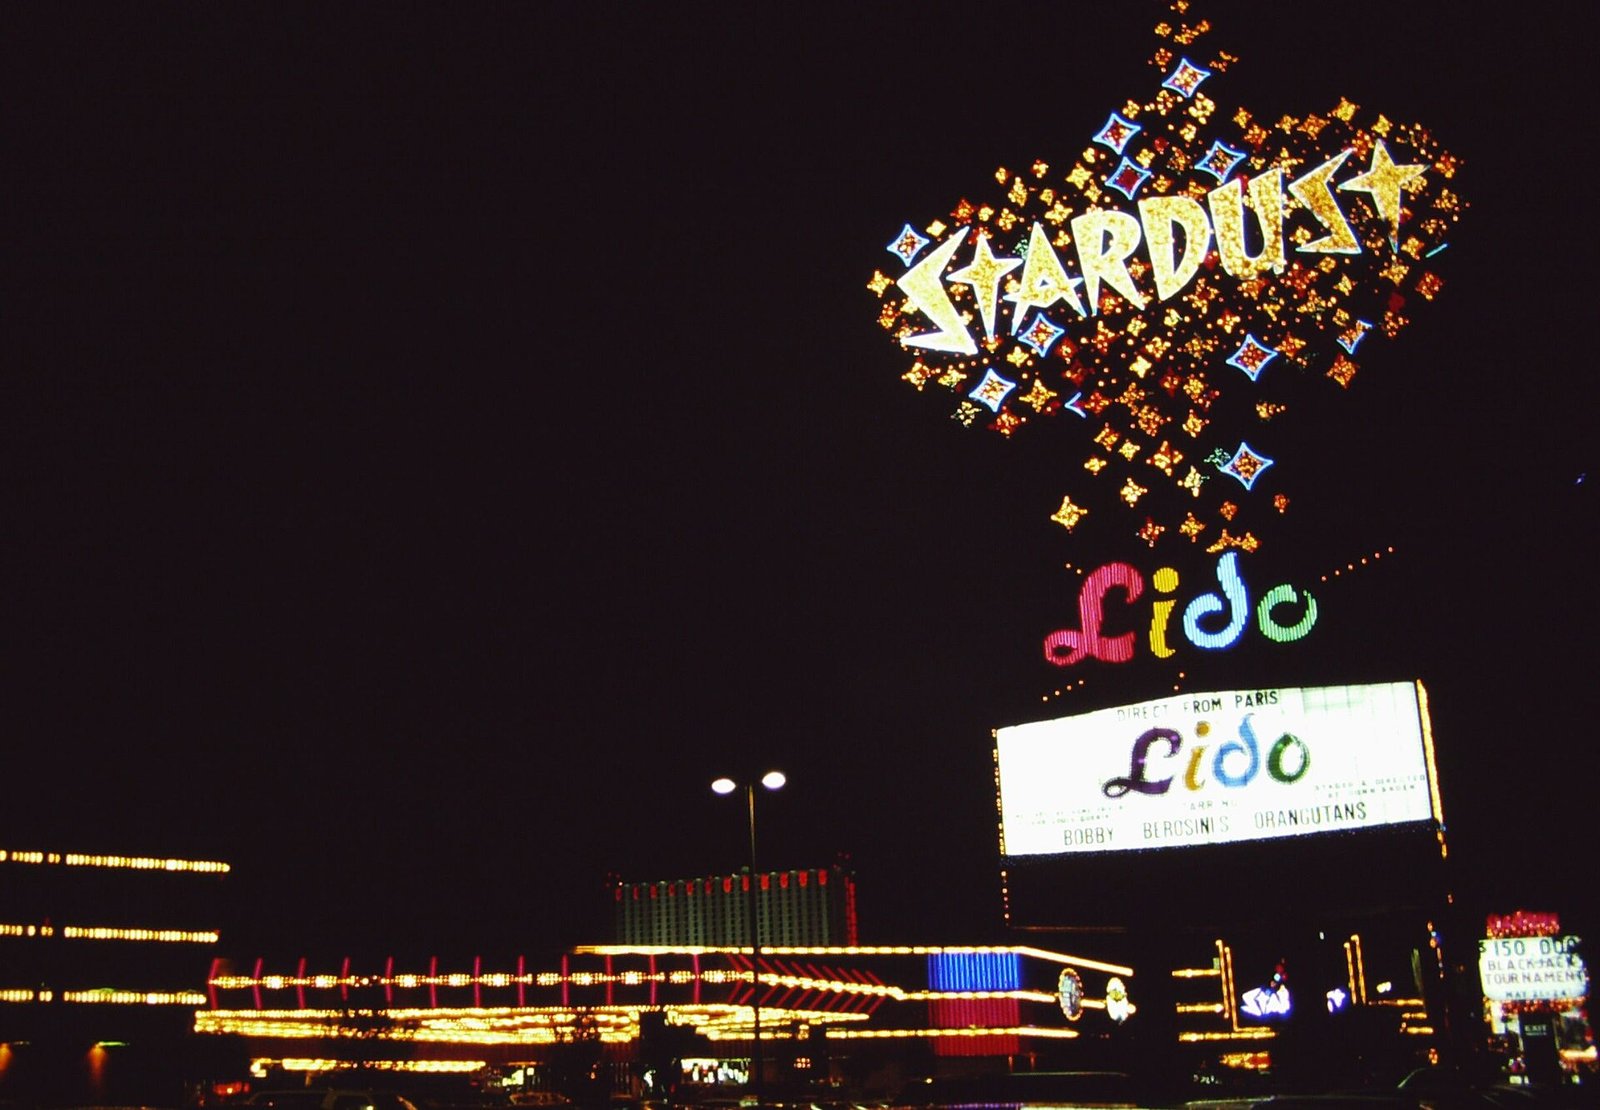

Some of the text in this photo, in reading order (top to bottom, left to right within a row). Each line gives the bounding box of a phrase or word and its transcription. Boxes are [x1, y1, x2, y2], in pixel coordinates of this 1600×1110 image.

[897, 138, 1431, 355] STARDUST
[1043, 551, 1318, 666] Lido
[1116, 690, 1279, 722] DIRECT FROM PARIS
[1102, 712, 1311, 799] Lido
[1063, 826, 1115, 846] BOBBY
[1254, 801, 1367, 830] ORANGUTANS
[1485, 970, 1584, 985] TOURNAMENT
